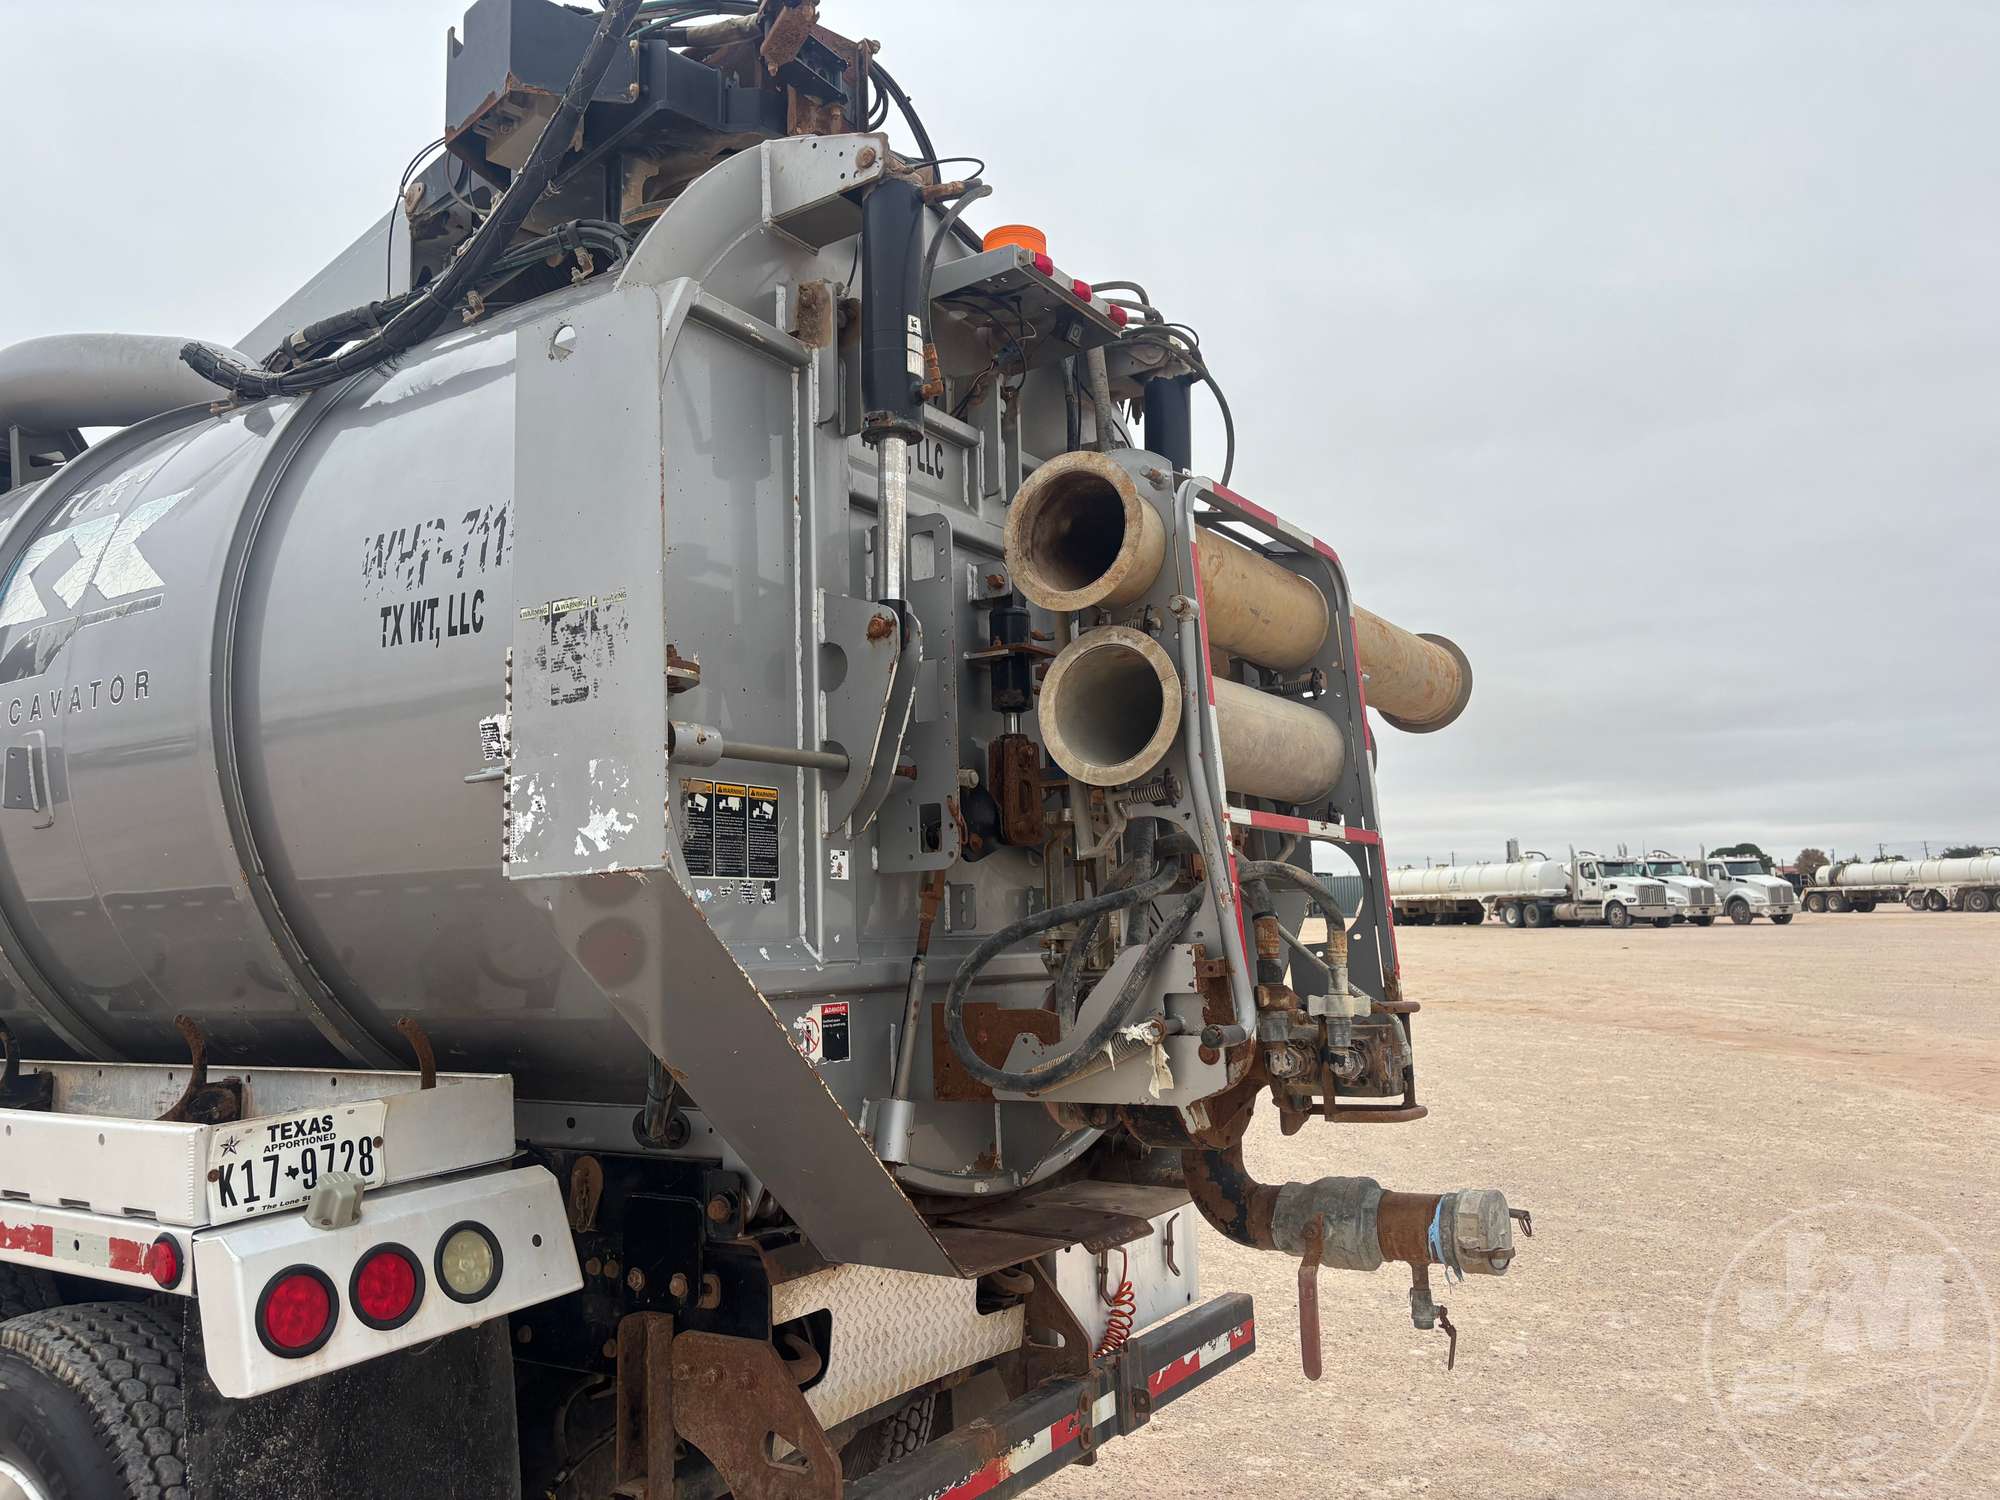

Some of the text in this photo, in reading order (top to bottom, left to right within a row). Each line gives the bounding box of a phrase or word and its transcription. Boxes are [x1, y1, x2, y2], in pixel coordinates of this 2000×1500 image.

[916, 438, 944, 480] LLC
[380, 603, 405, 648] TX
[447, 589, 485, 637] LLC
[560, 600, 587, 611] WARNING
[8, 671, 150, 725] CAVATOR
[263, 1133, 337, 1153] APPORTIONED
[267, 1114, 334, 1143] TEXAS
[218, 1136, 374, 1208] K17 9728
[280, 1198, 300, 1208] Lone
